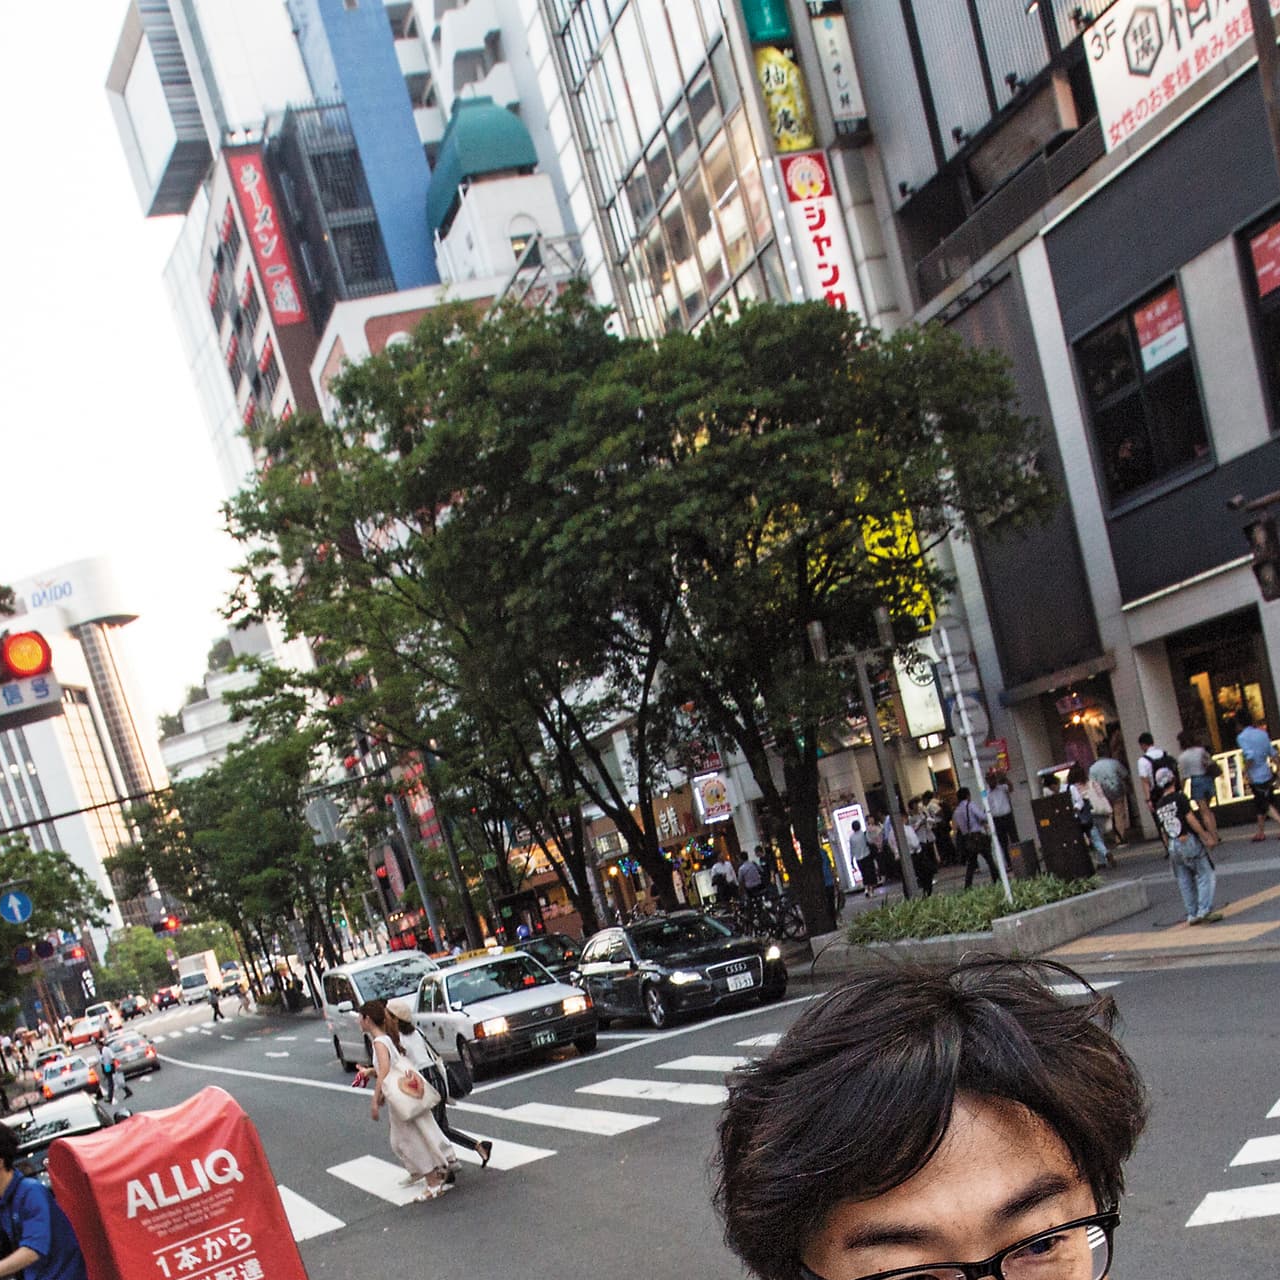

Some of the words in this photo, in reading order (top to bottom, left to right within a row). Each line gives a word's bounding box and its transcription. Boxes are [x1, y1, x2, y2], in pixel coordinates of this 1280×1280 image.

[1090, 19, 1117, 61] 3F
[1108, 63, 1192, 146] 女性のお客様
[32, 581, 73, 608] DAIDO
[127, 1148, 245, 1219] ALLIQ
[155, 1227, 252, 1278] 1本から
